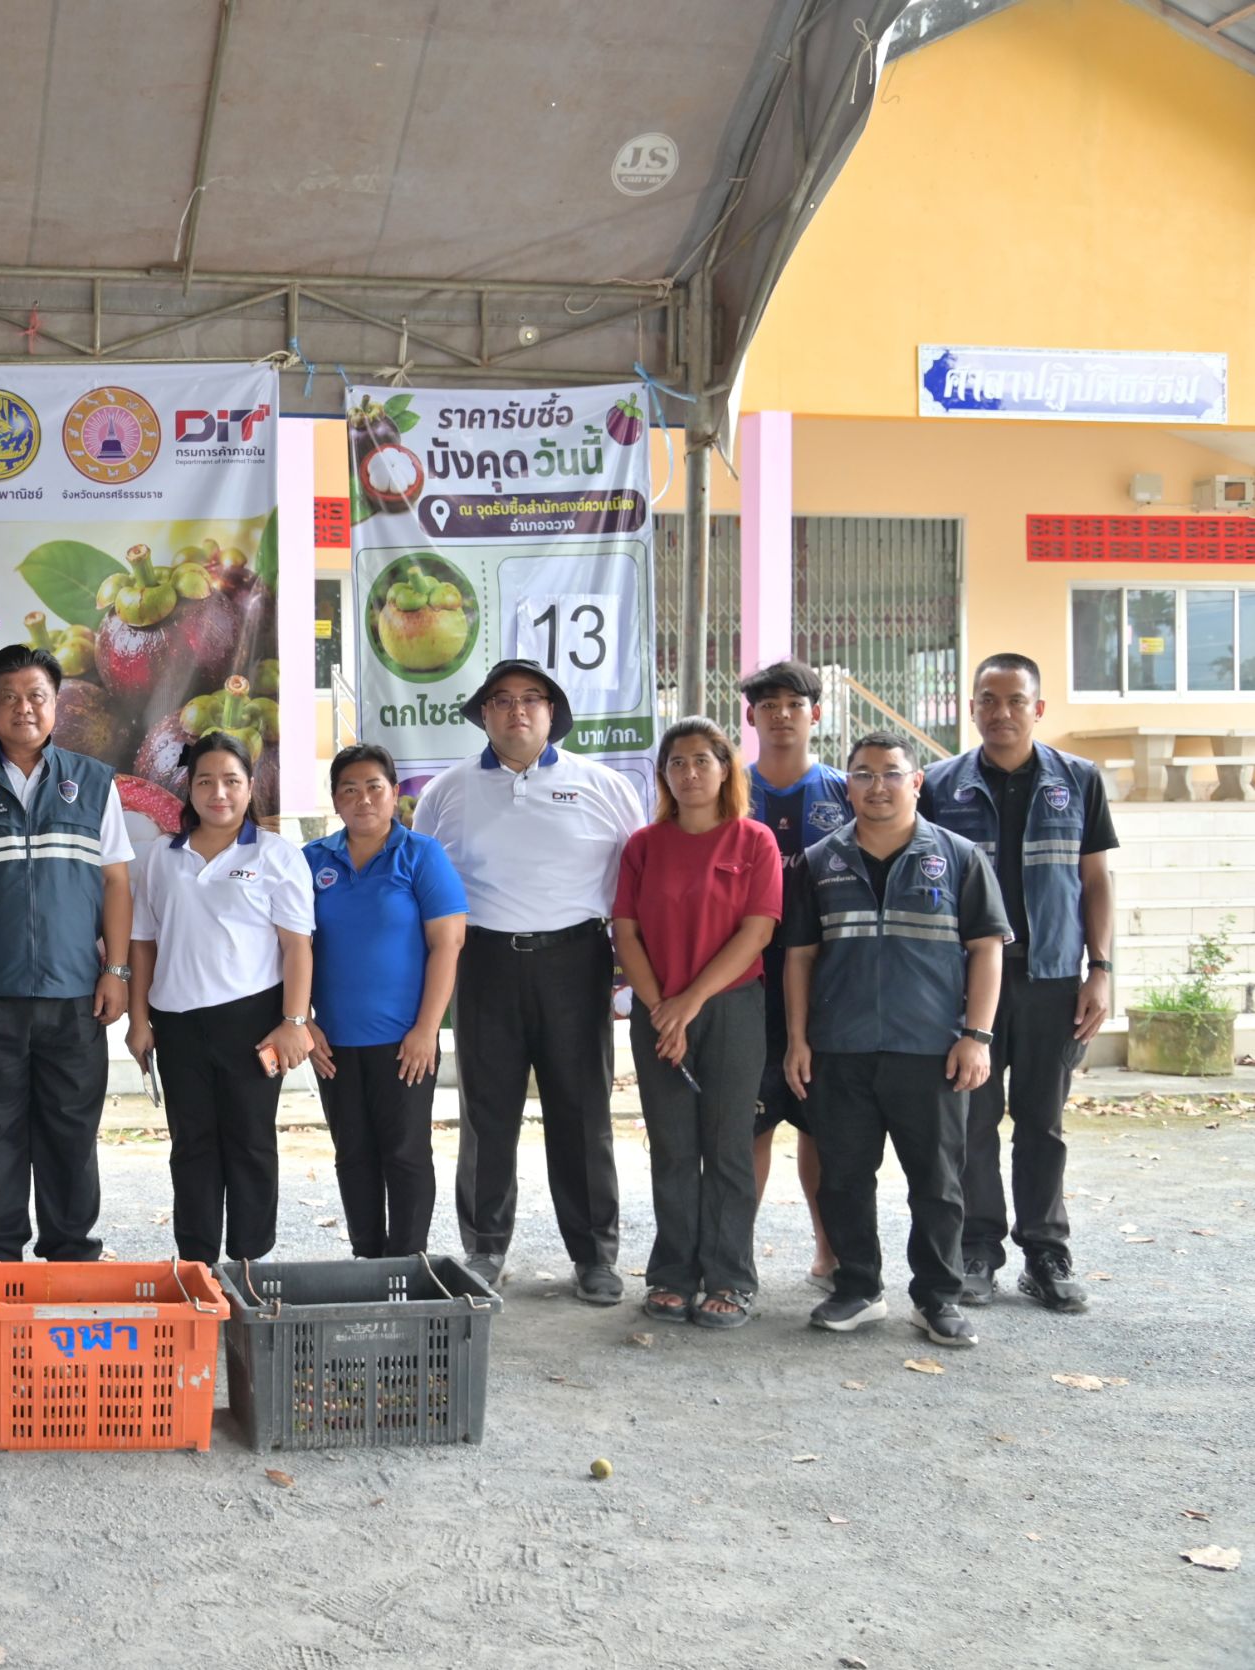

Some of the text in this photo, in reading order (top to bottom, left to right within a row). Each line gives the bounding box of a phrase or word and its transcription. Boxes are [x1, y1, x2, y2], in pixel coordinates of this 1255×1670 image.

[620, 147, 669, 169] JS
[438, 392, 573, 429] ราคารับซื้อ
[176, 445, 265, 457] กรมการค้าภายใน
[62, 489, 163, 500] จังหวัดนครศรีธรรมราช
[510, 518, 575, 532] อำเภอฉวาง
[533, 604, 607, 670] 13
[578, 725, 643, 747] บาท/กก.
